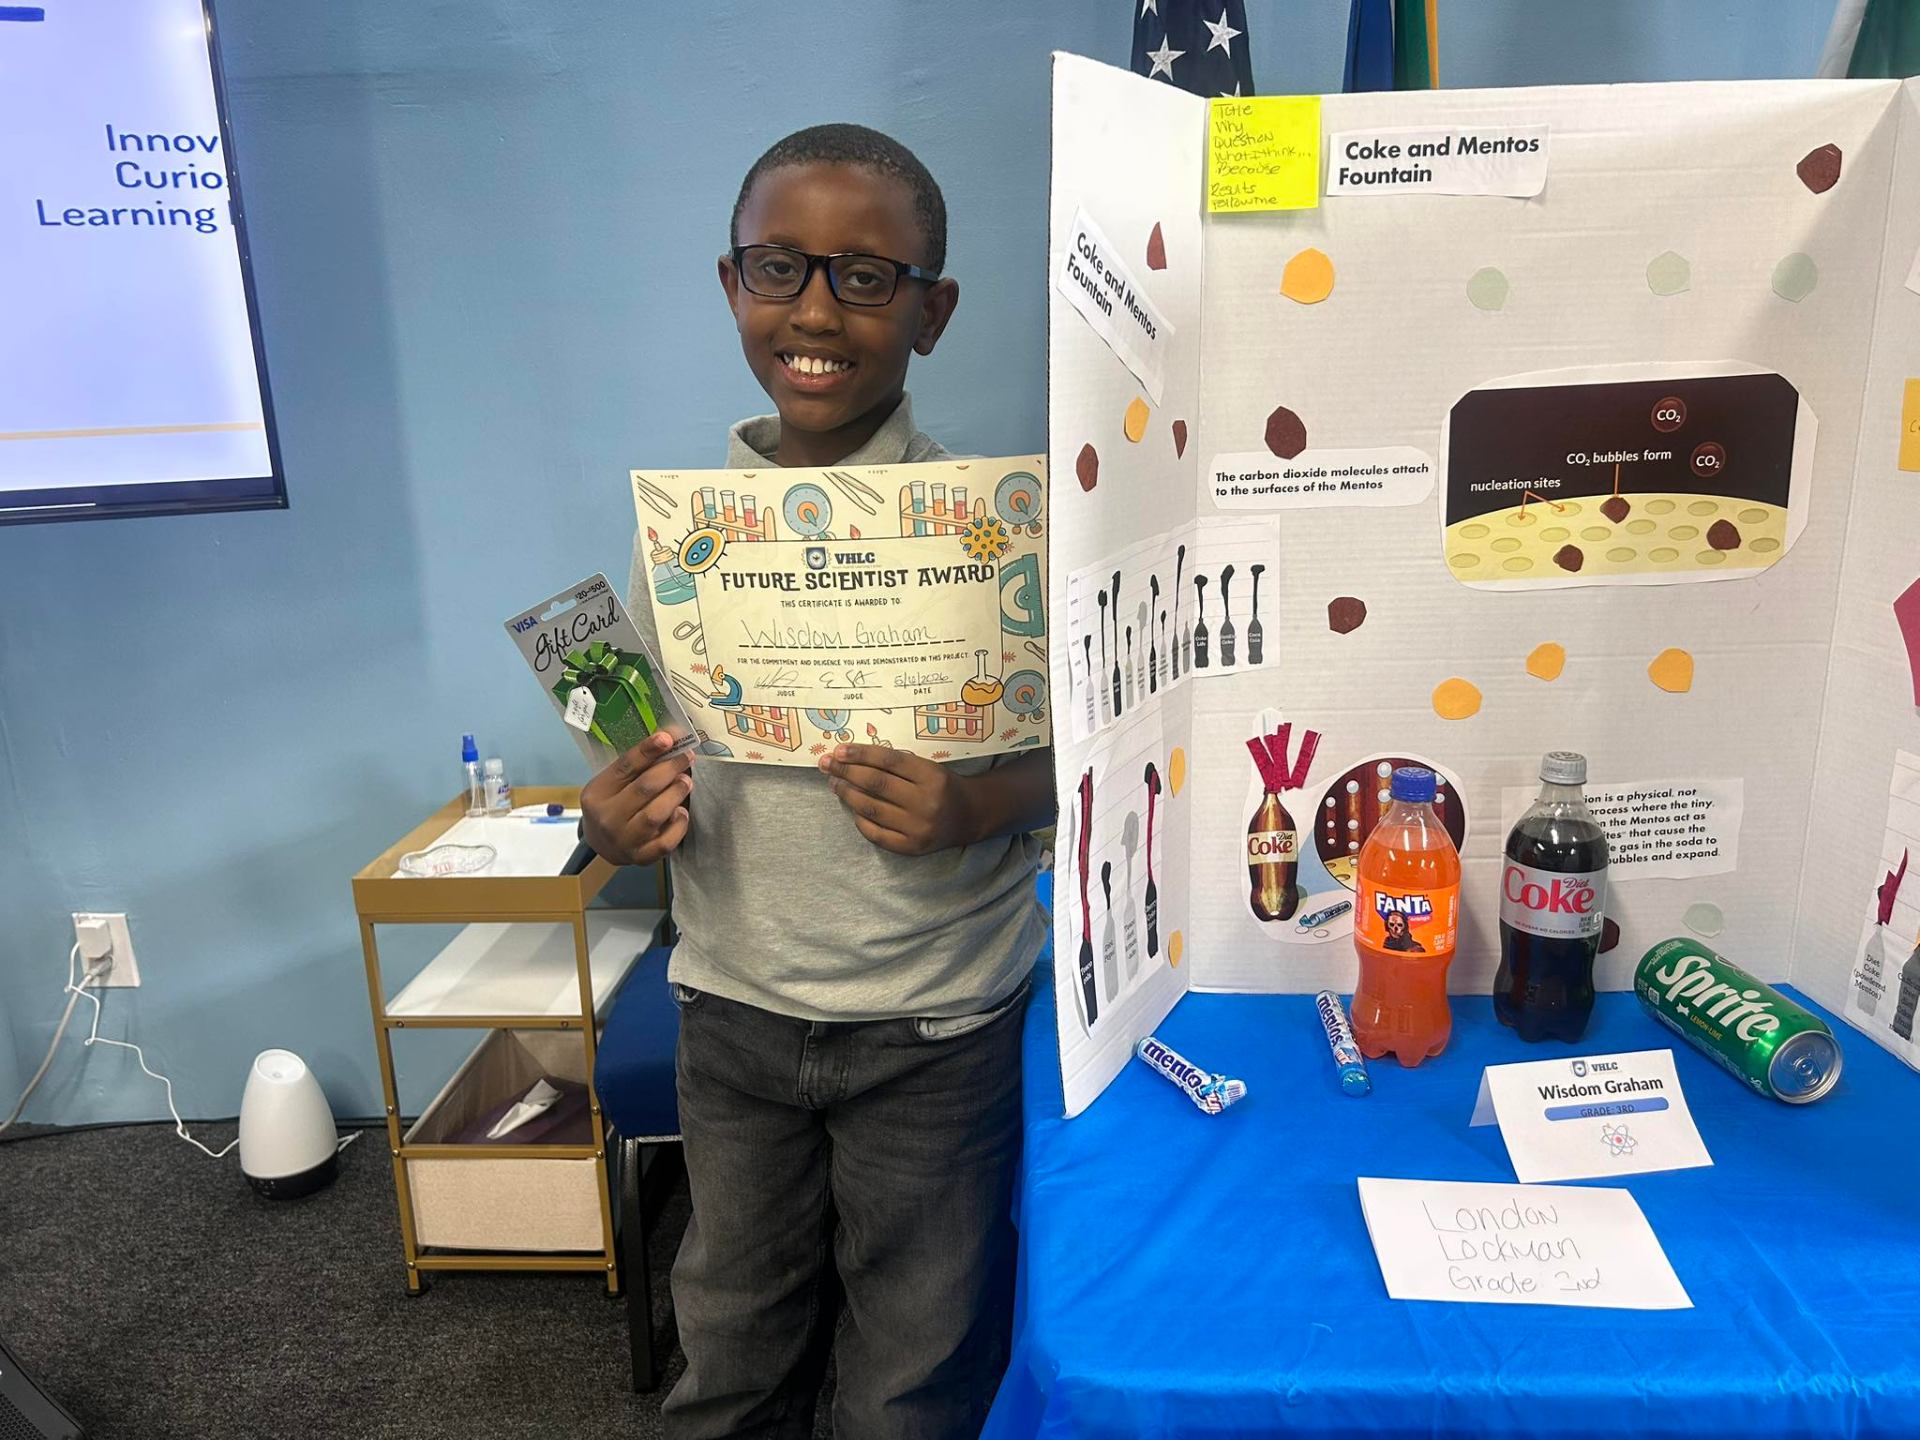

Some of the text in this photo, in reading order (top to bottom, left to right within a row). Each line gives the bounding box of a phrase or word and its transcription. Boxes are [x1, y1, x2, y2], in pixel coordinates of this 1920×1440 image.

[1215, 120, 1244, 136] Why
[1345, 136, 1540, 160] Coke and Mentos
[1338, 165, 1433, 186] Fountain
[36, 198, 218, 233] Learning
[1067, 253, 1112, 317] Fountain
[1077, 232, 1157, 340] Coke and Mentos
[1592, 450, 1639, 464] bubbles
[1643, 449, 1672, 462] form
[1215, 463, 1429, 483] The carbon dioxide molecules attach
[1215, 480, 1384, 497] to the surfaces of the Mentos
[1470, 477, 1561, 493] nucleation sites
[834, 552, 876, 565] VHLC
[720, 564, 995, 592] FUTURE SCIENTIST AWARD
[781, 600, 796, 608] THIS
[798, 599, 842, 608] CERTIFICATE
[845, 599, 852, 607] IS
[854, 598, 888, 607] AWARDED
[512, 616, 538, 634] VISA
[740, 618, 937, 648] Wisdom Graham
[533, 596, 620, 673] Gift Card
[737, 657, 748, 665] FOR
[872, 656, 919, 665] DEMONSTRATED
[843, 692, 864, 700] JUDGE
[913, 686, 932, 695] DATE
[1604, 793, 1614, 802] is
[1616, 794, 1624, 802] a
[1677, 788, 1697, 797] not
[1631, 803, 1667, 813] where
[1670, 800, 1688, 810] the
[1609, 818, 1627, 827] the
[1629, 814, 1671, 826] Mentos
[1673, 813, 1690, 822] act
[1693, 813, 1706, 821] as
[1629, 828, 1652, 838] that
[1654, 826, 1686, 836] cause
[1688, 824, 1706, 834] the
[1247, 836, 1293, 856] Coke
[1619, 844, 1639, 853] gas
[1642, 841, 1652, 850] in
[1655, 839, 1673, 849] the
[1675, 836, 1703, 847] soda
[1705, 836, 1717, 846] to
[1651, 850, 1673, 861] and
[1504, 866, 1595, 914] Coke
[1562, 877, 1590, 889] Diet
[1375, 892, 1432, 915] FANTA
[1863, 963, 1881, 978] Coke
[1655, 955, 1781, 1042] Sprite
[1317, 995, 1344, 1048] mentos
[1591, 1061, 1618, 1072] VHLC
[1537, 1077, 1664, 1101] Wisdom Graham
[1580, 1104, 1635, 1118] GRADE: 3RD
[1421, 1197, 1559, 1233] London
[1448, 1265, 1538, 1295] Grade
